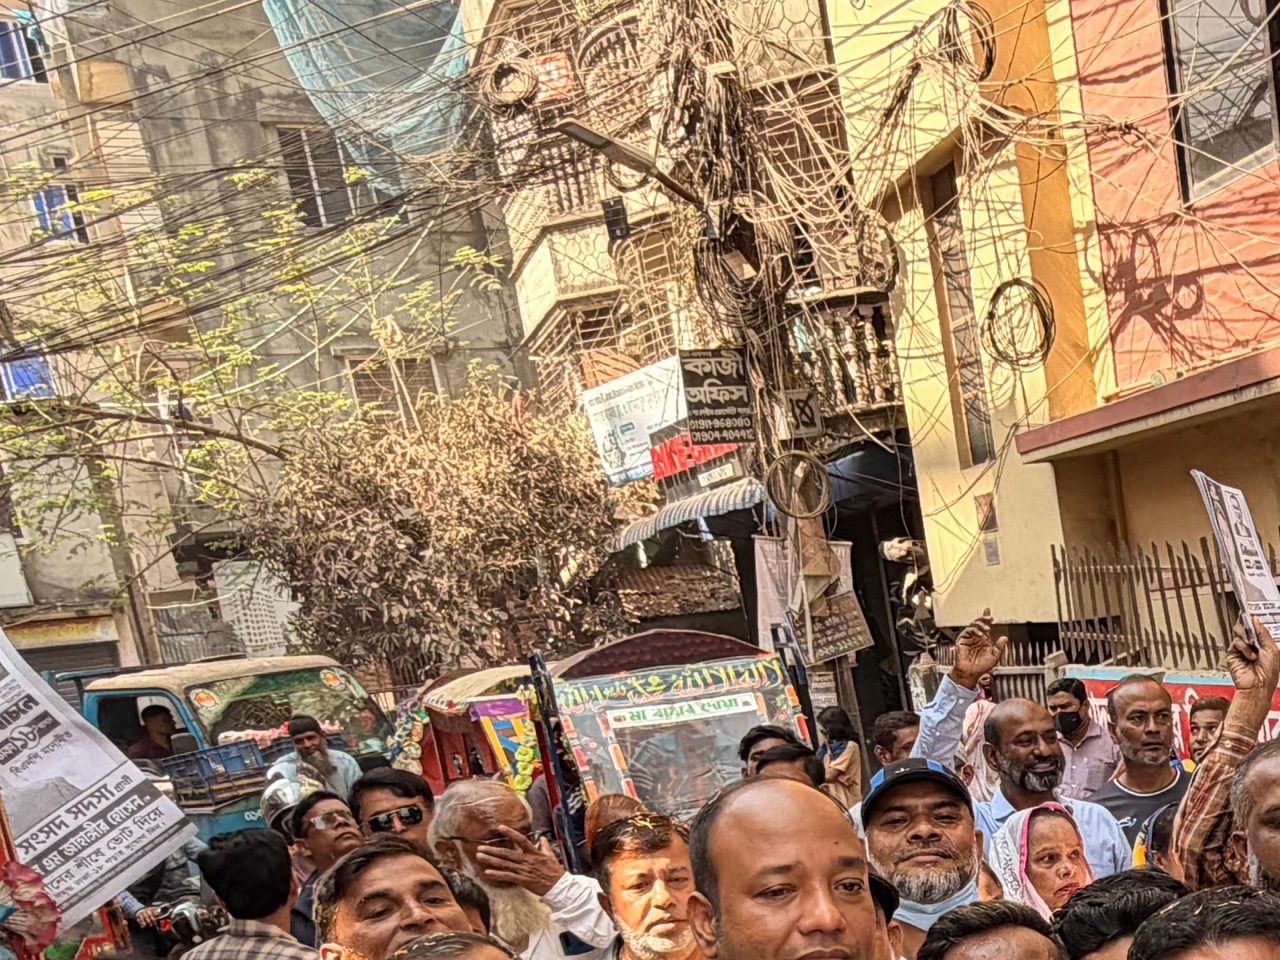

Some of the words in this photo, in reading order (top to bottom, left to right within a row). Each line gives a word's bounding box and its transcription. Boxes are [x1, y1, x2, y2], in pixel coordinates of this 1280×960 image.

[682, 350, 744, 378] কাজী
[685, 378, 748, 403] অফিস
[16, 815, 70, 856] সংসদ
[65, 783, 117, 821] সদস্য
[42, 853, 65, 871] এম
[63, 819, 110, 857] জাহাঙ্গীর
[107, 794, 144, 826] হোসেন
[45, 868, 75, 893] ানের
[75, 849, 106, 872] শীষে
[107, 826, 135, 851] ভোট
[133, 805, 165, 831] দিয়ে
